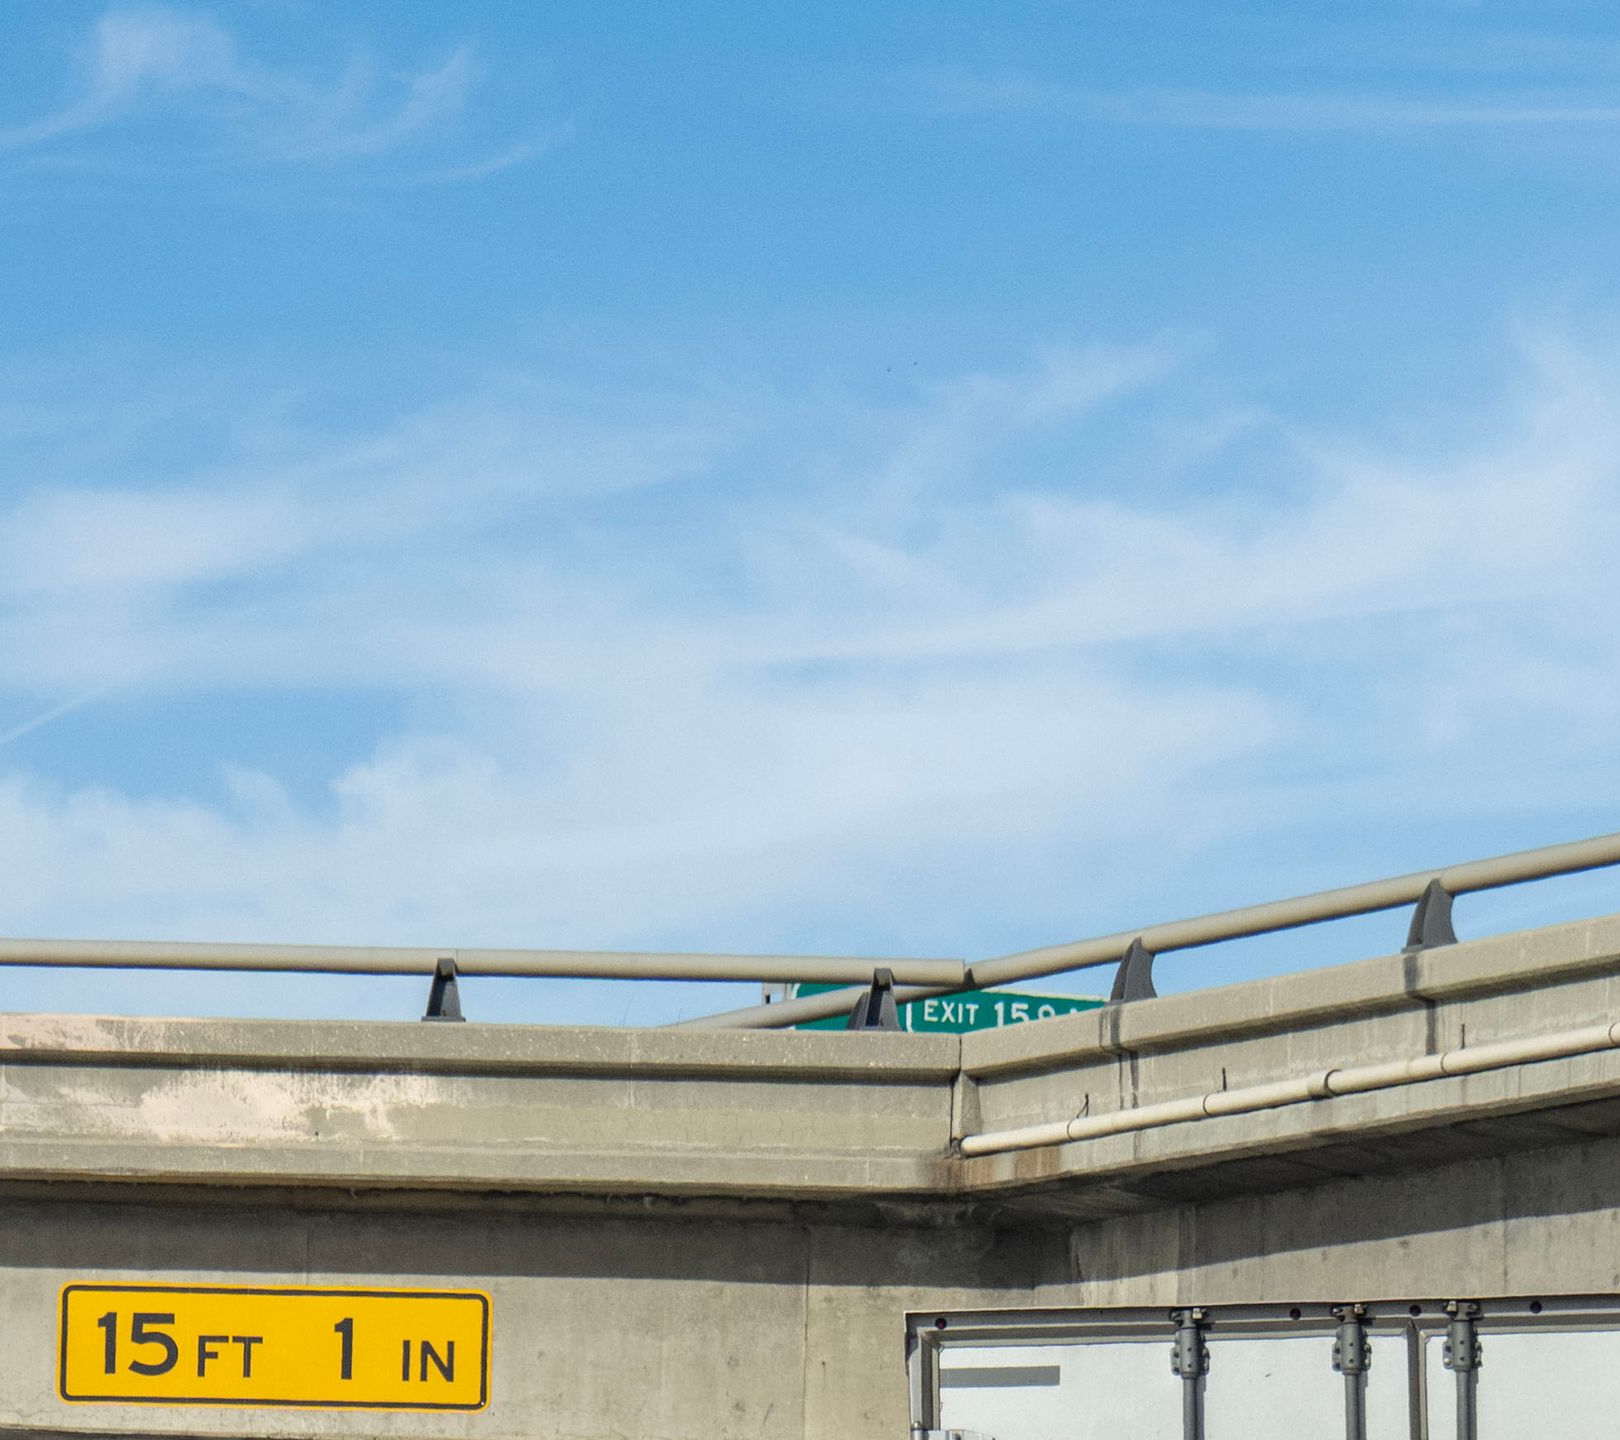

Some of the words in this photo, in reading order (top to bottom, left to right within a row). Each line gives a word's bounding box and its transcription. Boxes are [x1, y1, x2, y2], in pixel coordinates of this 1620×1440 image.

[924, 999, 980, 1026] EXIT
[993, 1001, 1078, 1027] 159
[97, 1311, 179, 1377] 15
[197, 1335, 264, 1379] FT
[334, 1317, 354, 1381] 1
[401, 1339, 455, 1383] IN
